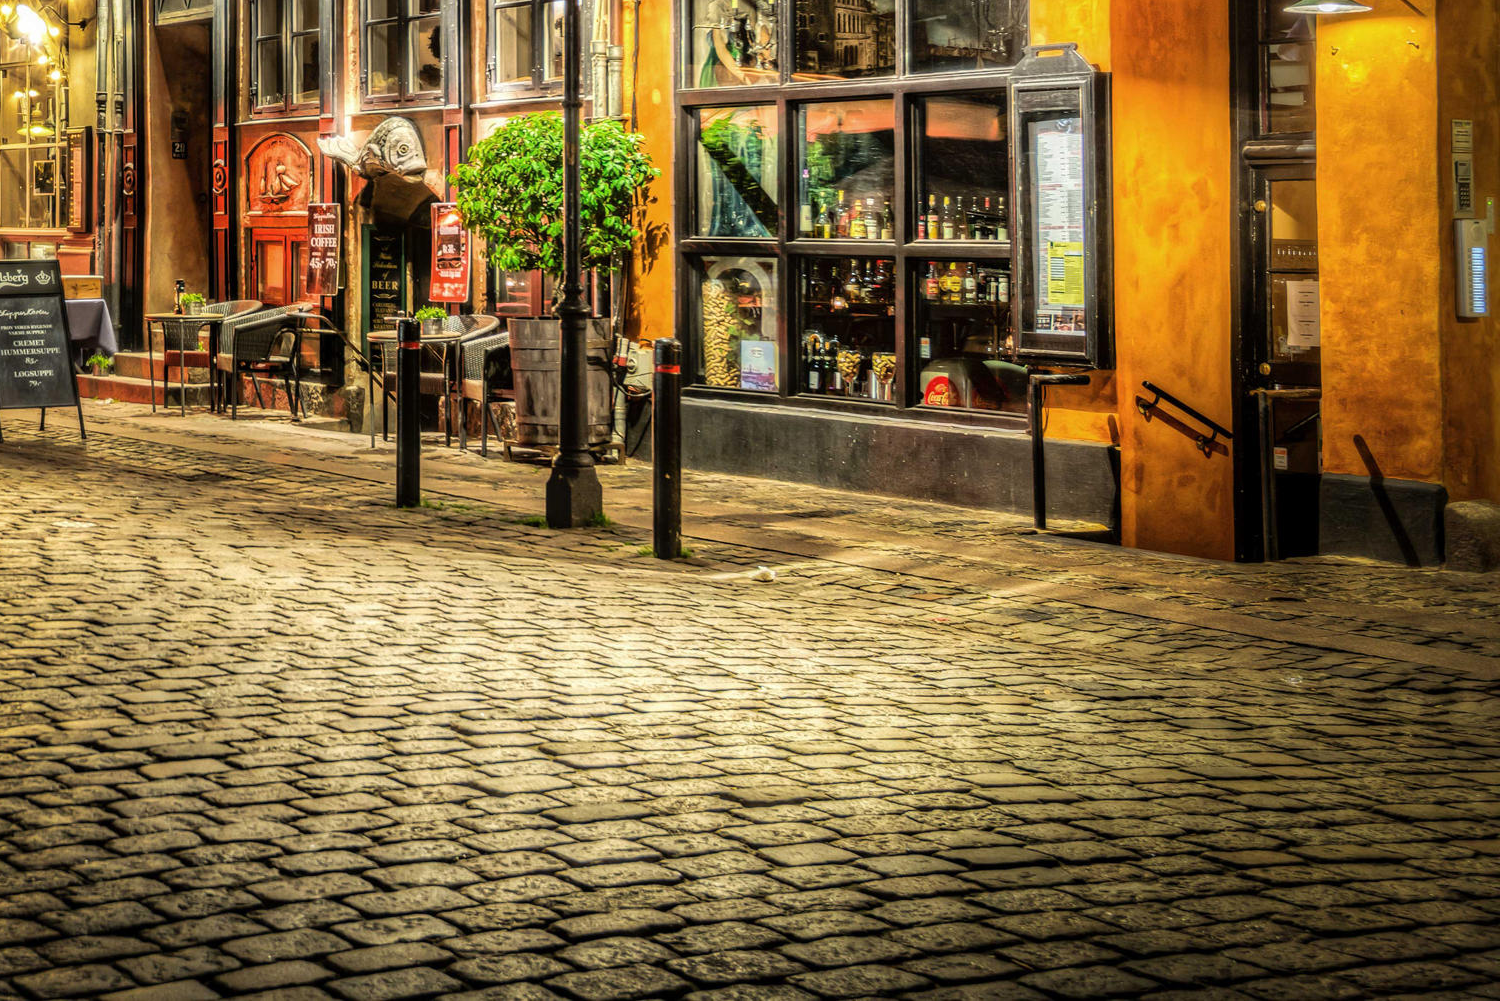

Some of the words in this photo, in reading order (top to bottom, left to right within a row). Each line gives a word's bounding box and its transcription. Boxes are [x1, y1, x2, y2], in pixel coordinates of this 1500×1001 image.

[313, 223, 335, 235] IRISH
[310, 237, 338, 248] COFFEE
[371, 280, 399, 291] BEER
[13, 339, 46, 347] CREMET
[0, 347, 61, 356] HUMMERSUPPE
